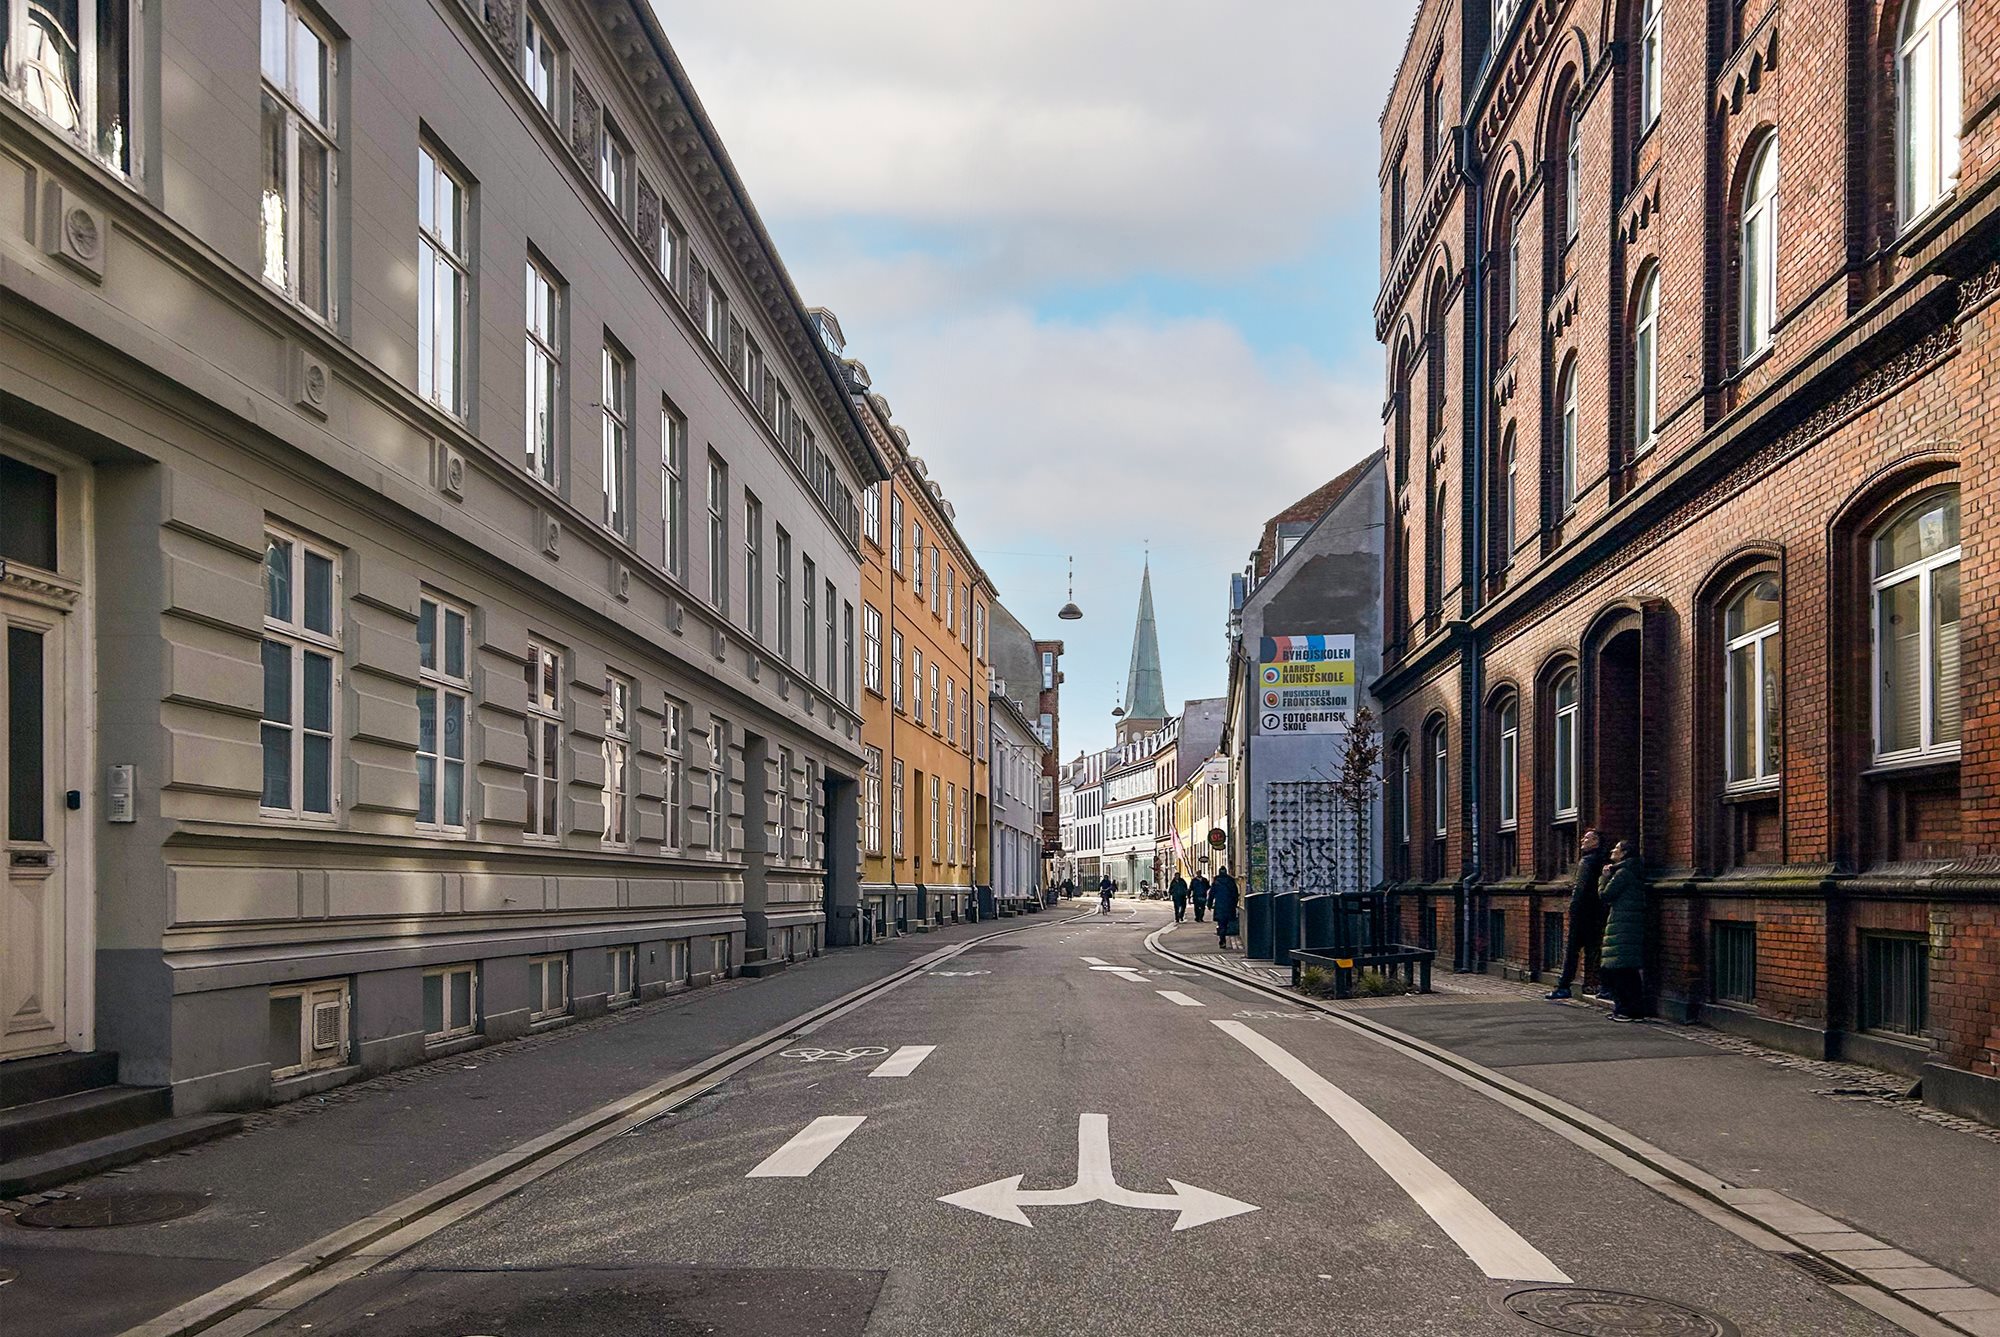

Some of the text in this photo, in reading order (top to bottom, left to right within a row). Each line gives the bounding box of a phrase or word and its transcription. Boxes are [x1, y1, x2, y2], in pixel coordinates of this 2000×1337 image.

[1283, 649, 1351, 660] BYHØJSKOLEN
[1283, 665, 1316, 673] AARHUS
[1283, 673, 1344, 683] KUNSTSKOLE
[1283, 697, 1347, 707] FRONTSESSION
[1283, 713, 1346, 722] FOTOGRAFISK
[1283, 723, 1307, 731] SKOLE
